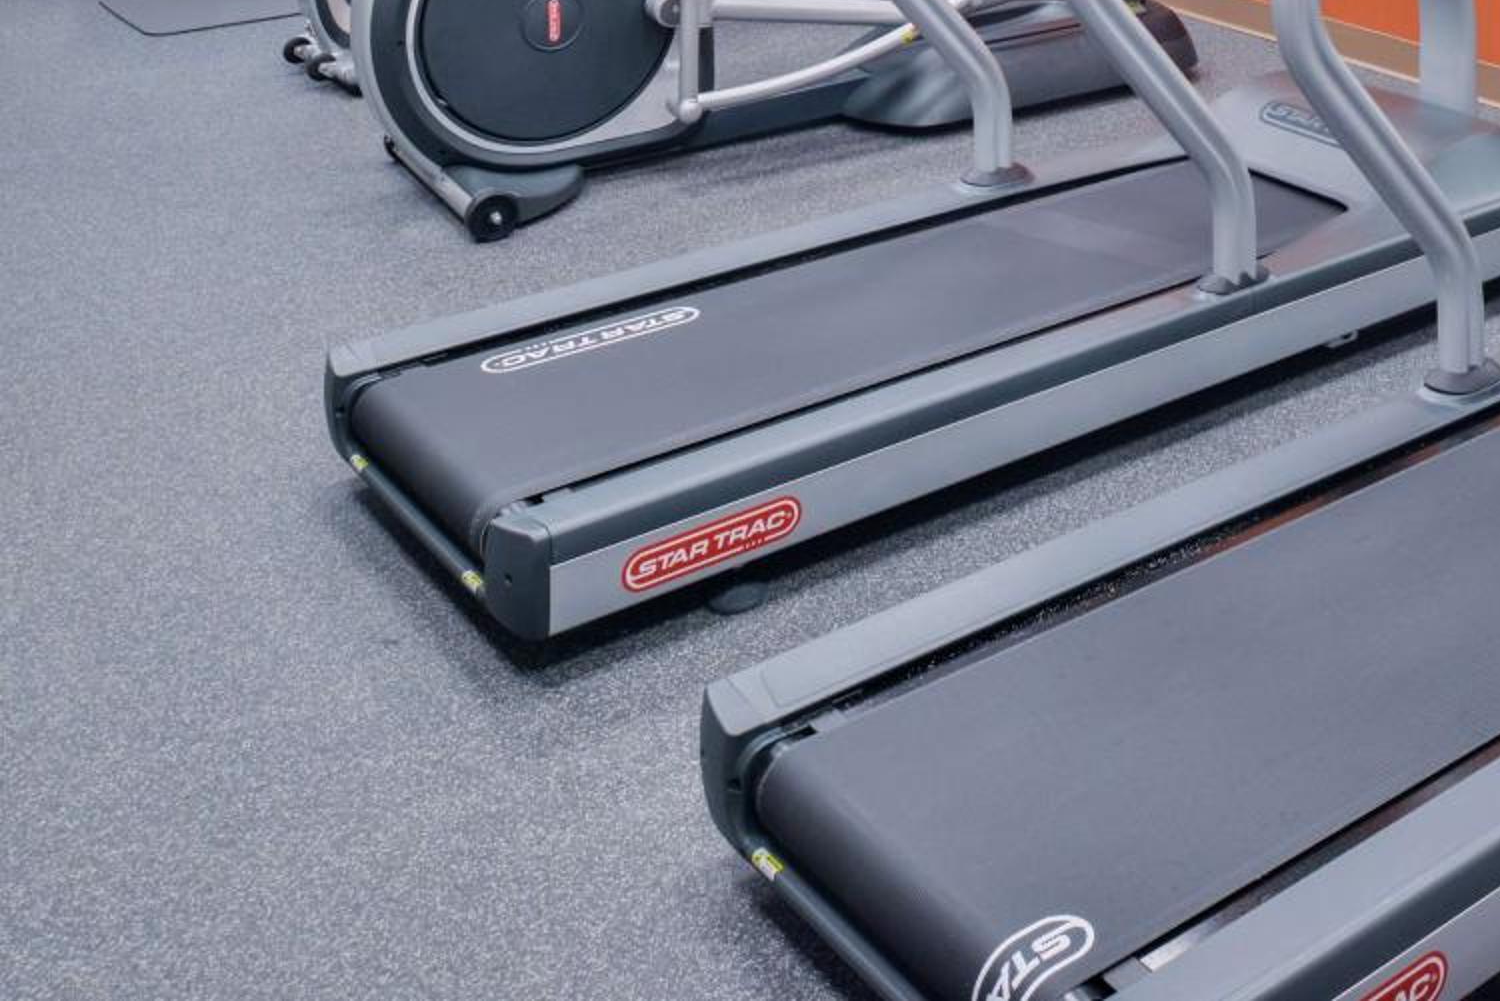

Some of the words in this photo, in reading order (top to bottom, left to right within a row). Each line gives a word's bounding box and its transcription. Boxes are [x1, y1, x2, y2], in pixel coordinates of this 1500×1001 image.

[602, 311, 686, 340] STAR
[501, 337, 599, 367] TRAC
[638, 539, 710, 576] STAR
[713, 510, 785, 547] TRAC
[985, 934, 1071, 1001] STA
